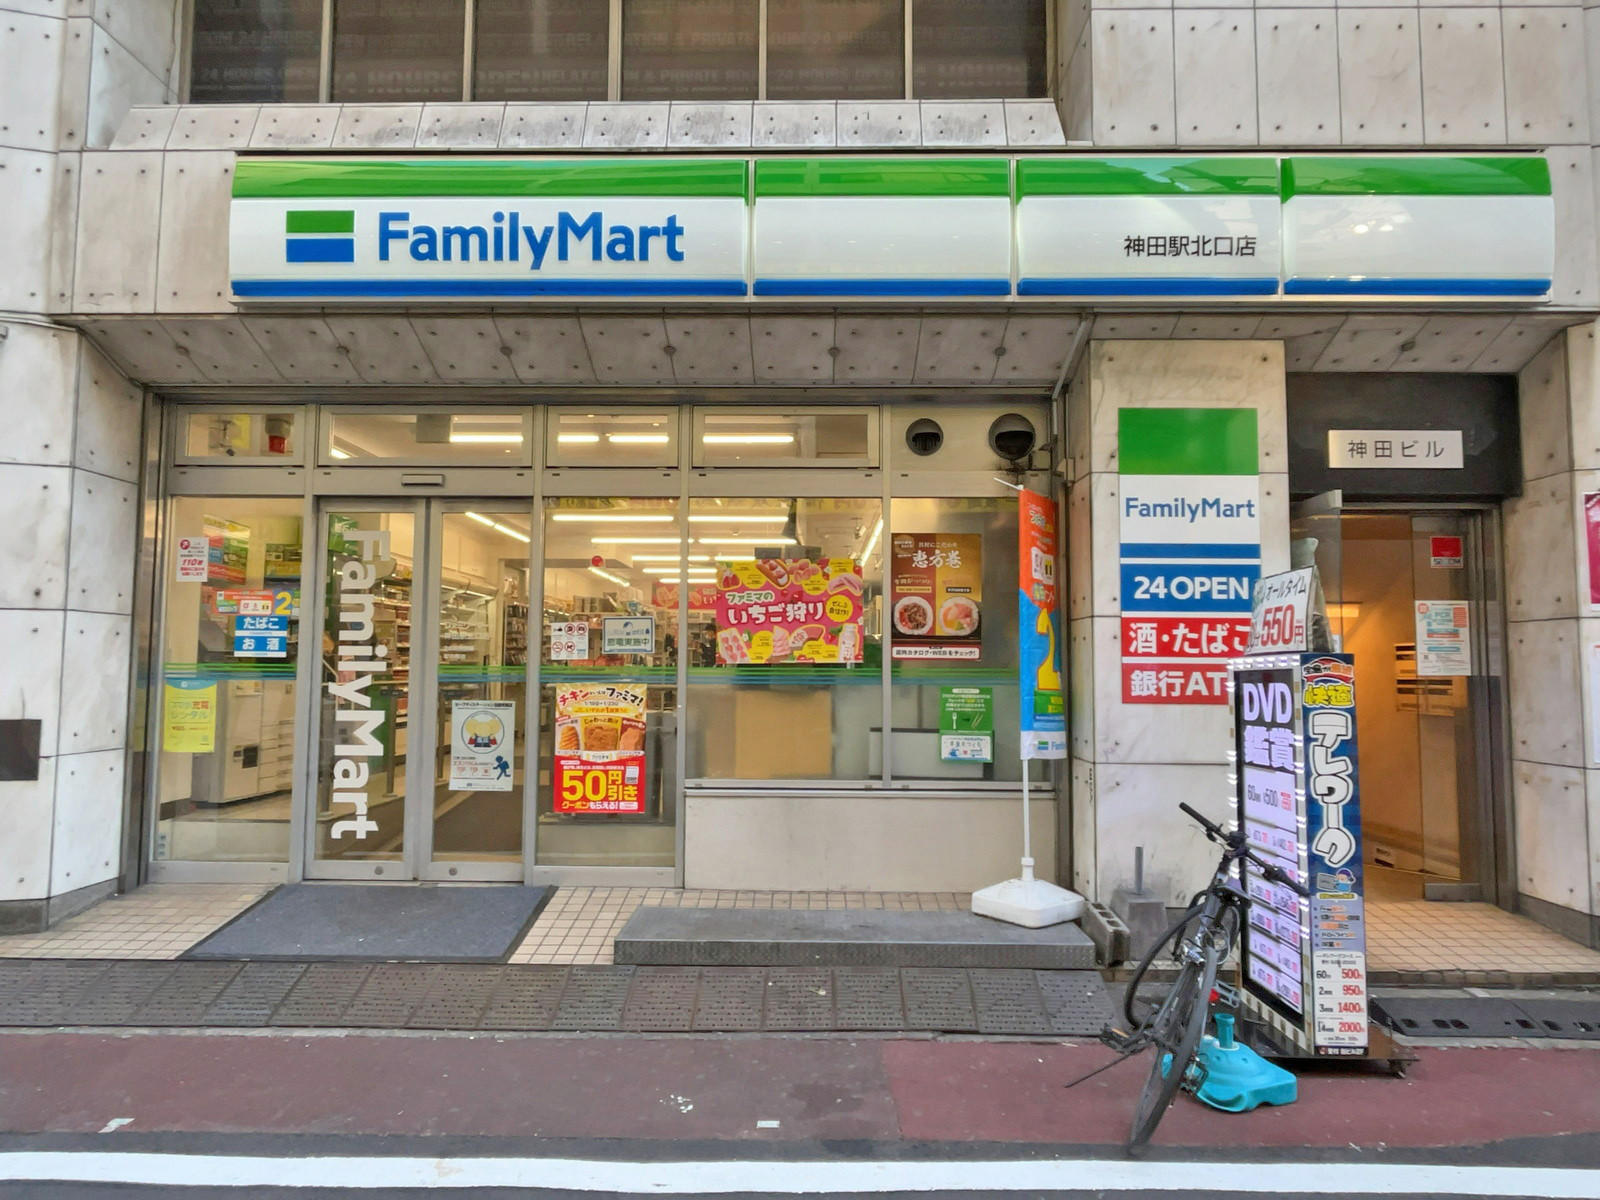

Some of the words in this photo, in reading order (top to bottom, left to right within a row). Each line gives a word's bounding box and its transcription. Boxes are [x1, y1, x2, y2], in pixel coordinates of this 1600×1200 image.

[379, 211, 685, 271] FamilyMart
[1123, 235, 1257, 258] 神田駅北口店
[1347, 440, 1444, 459] 神田ビル
[1125, 497, 1256, 523] FamilyMart
[726, 590, 775, 604] ファミマの
[243, 617, 279, 629] たばこ
[727, 601, 824, 625] いちご狩り
[328, 530, 391, 839] FamilyMart
[1130, 670, 1229, 698] 銀行AT
[1303, 684, 1354, 707] 快適
[1242, 682, 1293, 724] DVD
[1243, 726, 1296, 772] 鑑賞
[1311, 711, 1353, 866] テレワーク
